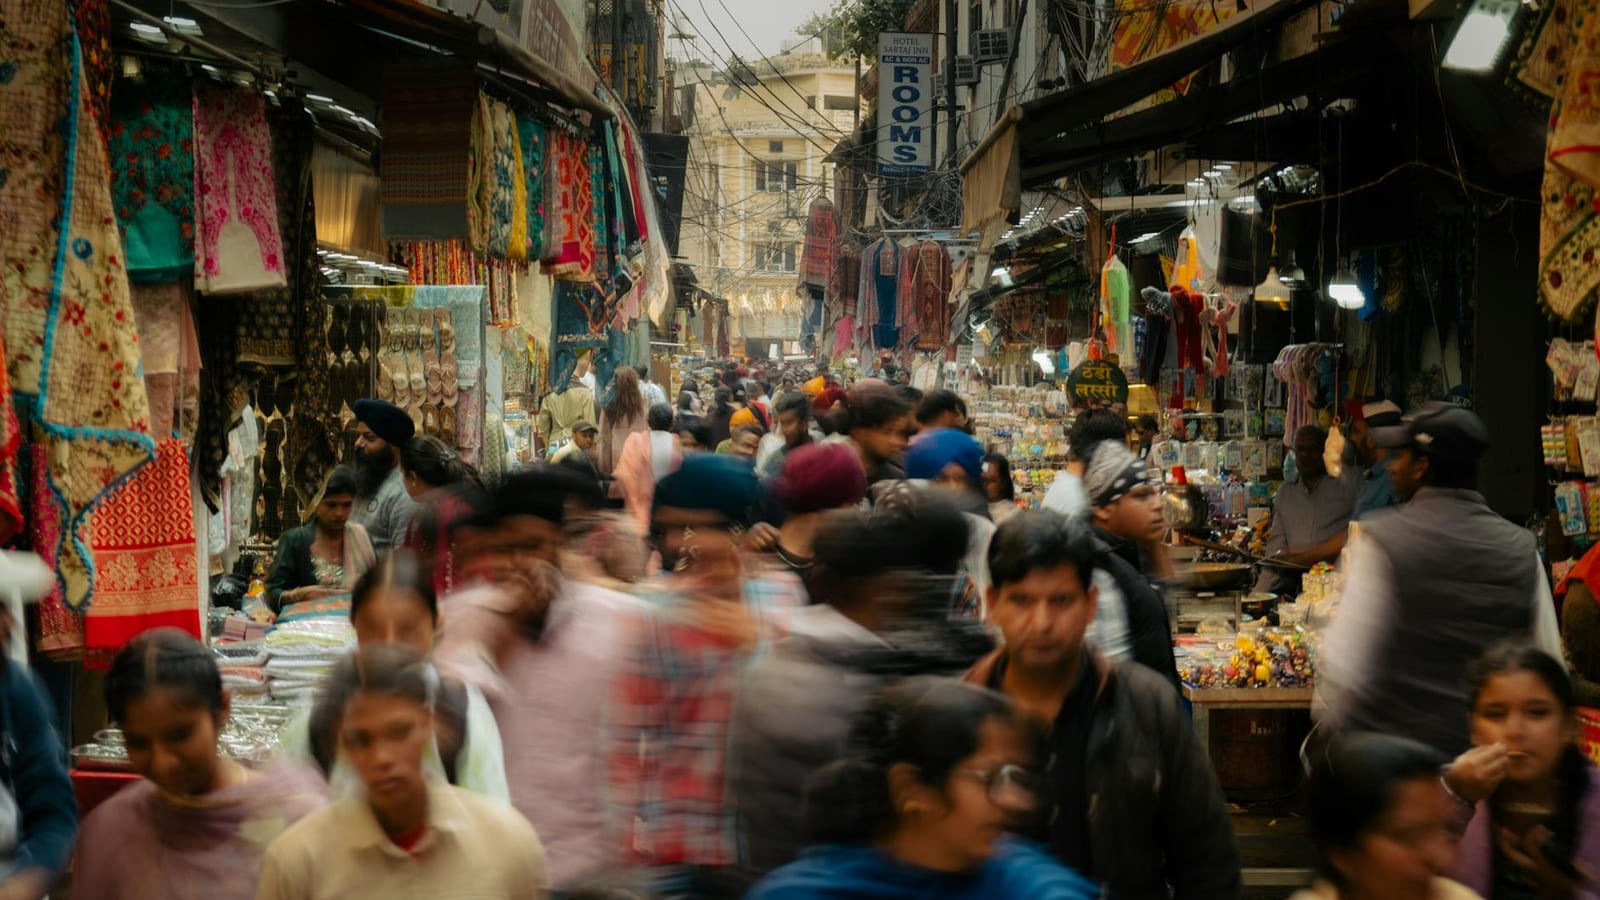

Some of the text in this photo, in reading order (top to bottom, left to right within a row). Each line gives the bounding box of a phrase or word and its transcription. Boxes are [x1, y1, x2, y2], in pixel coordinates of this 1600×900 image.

[893, 37, 920, 45] HOTEL
[883, 46, 911, 54] SARTAJ
[890, 66, 921, 163] ROOMS
[1076, 381, 1118, 399] लस्सी
